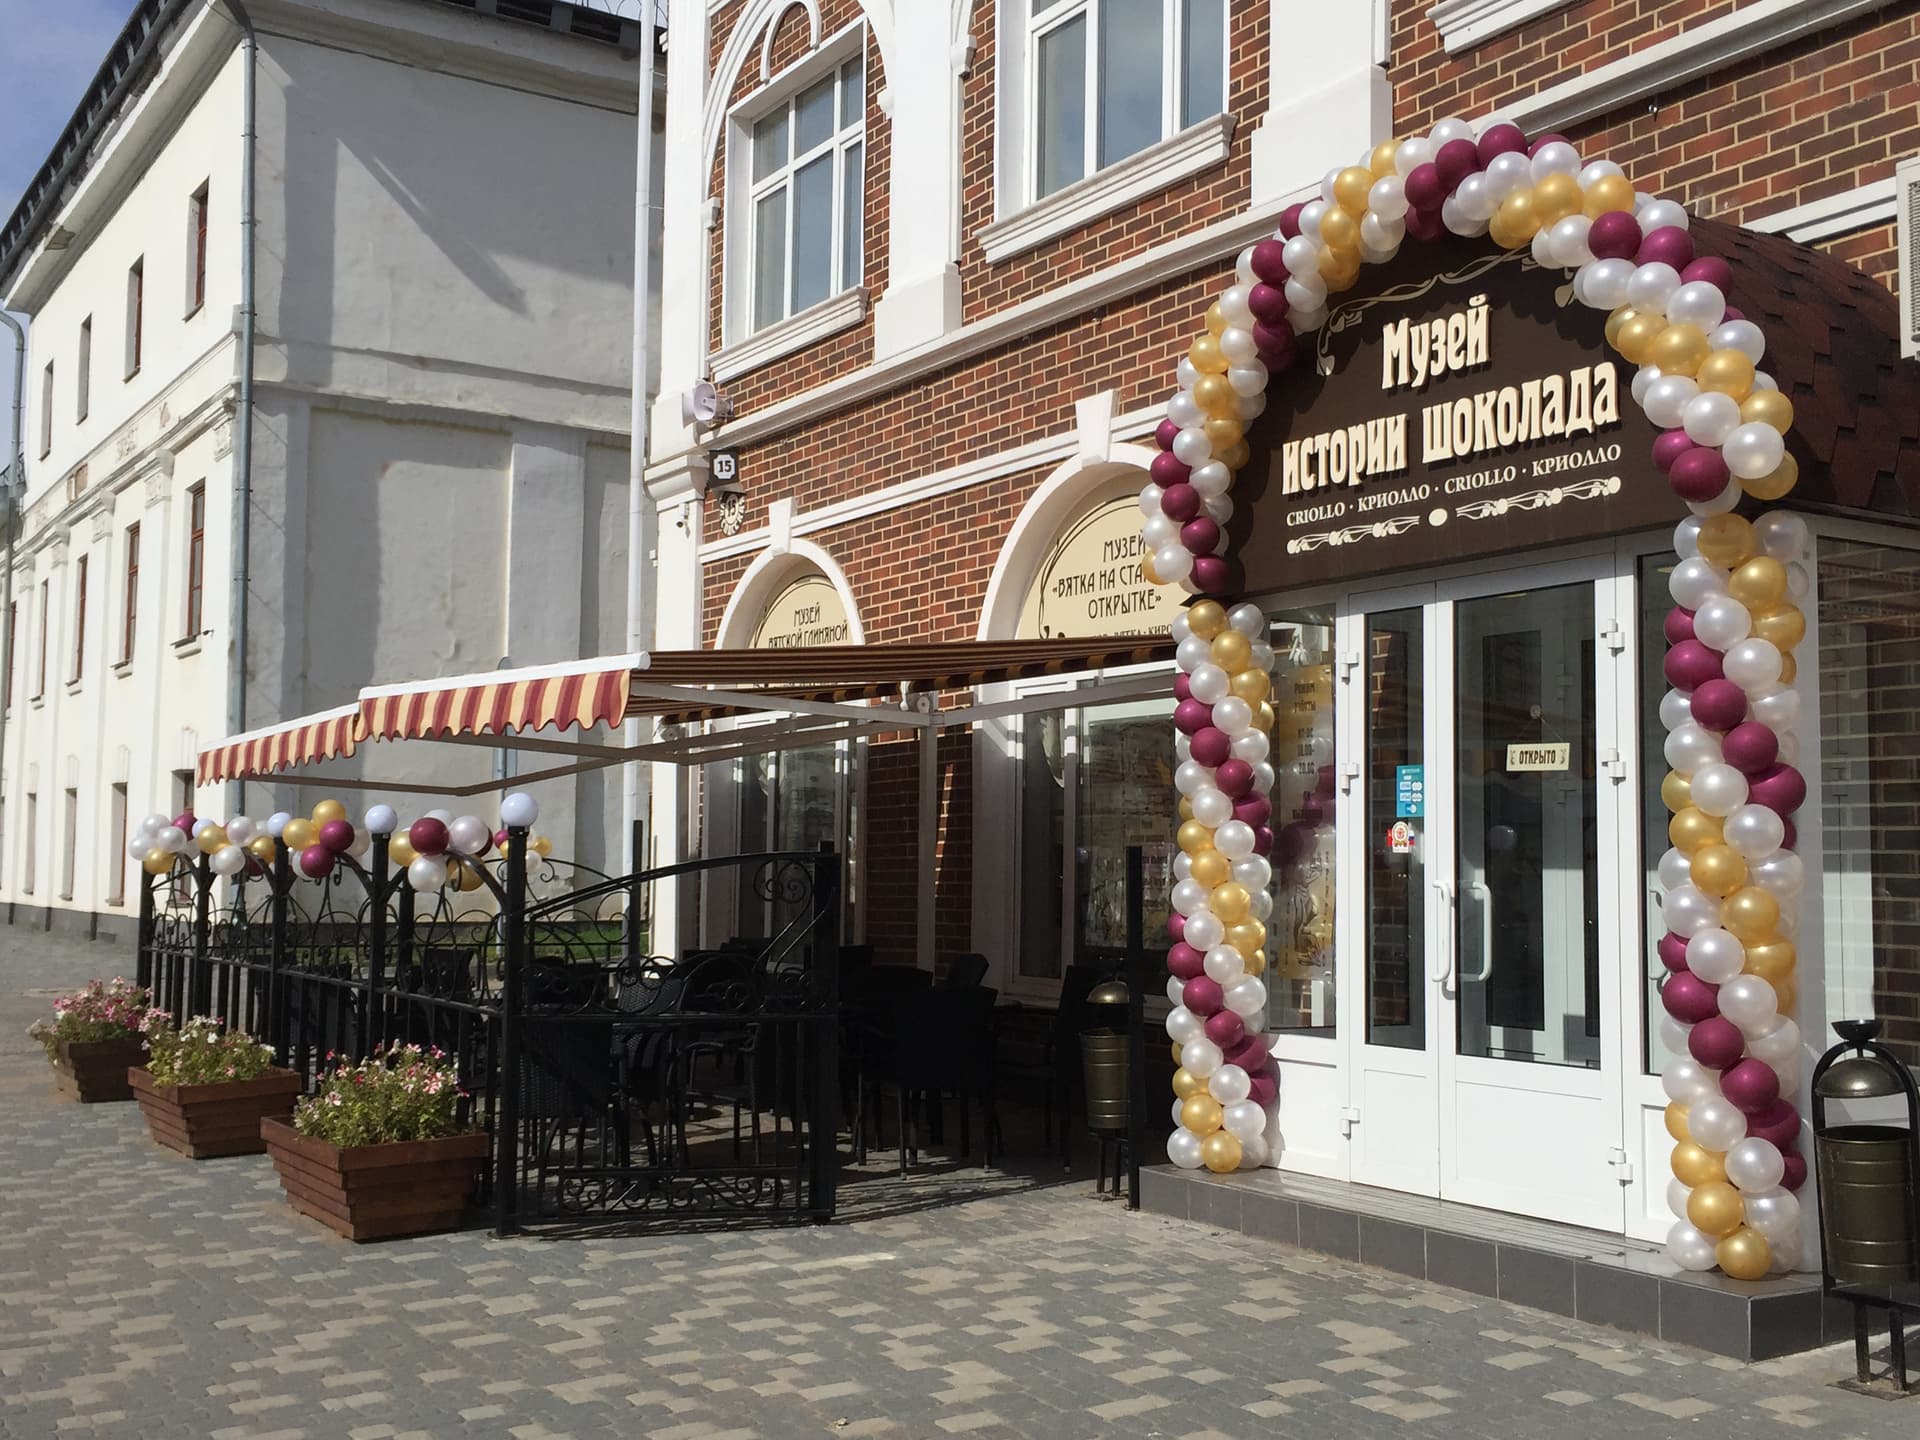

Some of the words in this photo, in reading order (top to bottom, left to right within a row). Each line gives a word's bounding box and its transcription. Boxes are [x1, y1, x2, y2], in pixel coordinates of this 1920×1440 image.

[1381, 293, 1492, 389] Музей
[717, 459, 732, 473] 15
[1286, 501, 1345, 528] CRIOLLO
[1357, 483, 1431, 514] КРИОЛЛО
[1444, 465, 1516, 495] CRIOLLO
[1531, 443, 1622, 478] КРИОЛЛО
[1103, 529, 1146, 562] МУЗЕЙ
[1099, 568, 1115, 591] НА
[793, 601, 821, 627] МУЗЕЙ
[1088, 589, 1162, 619] ОТКРЫТКЕ»
[804, 619, 848, 647] ГЛИНЯНОЙ
[1519, 749, 1556, 765] ОТКРЫТО
